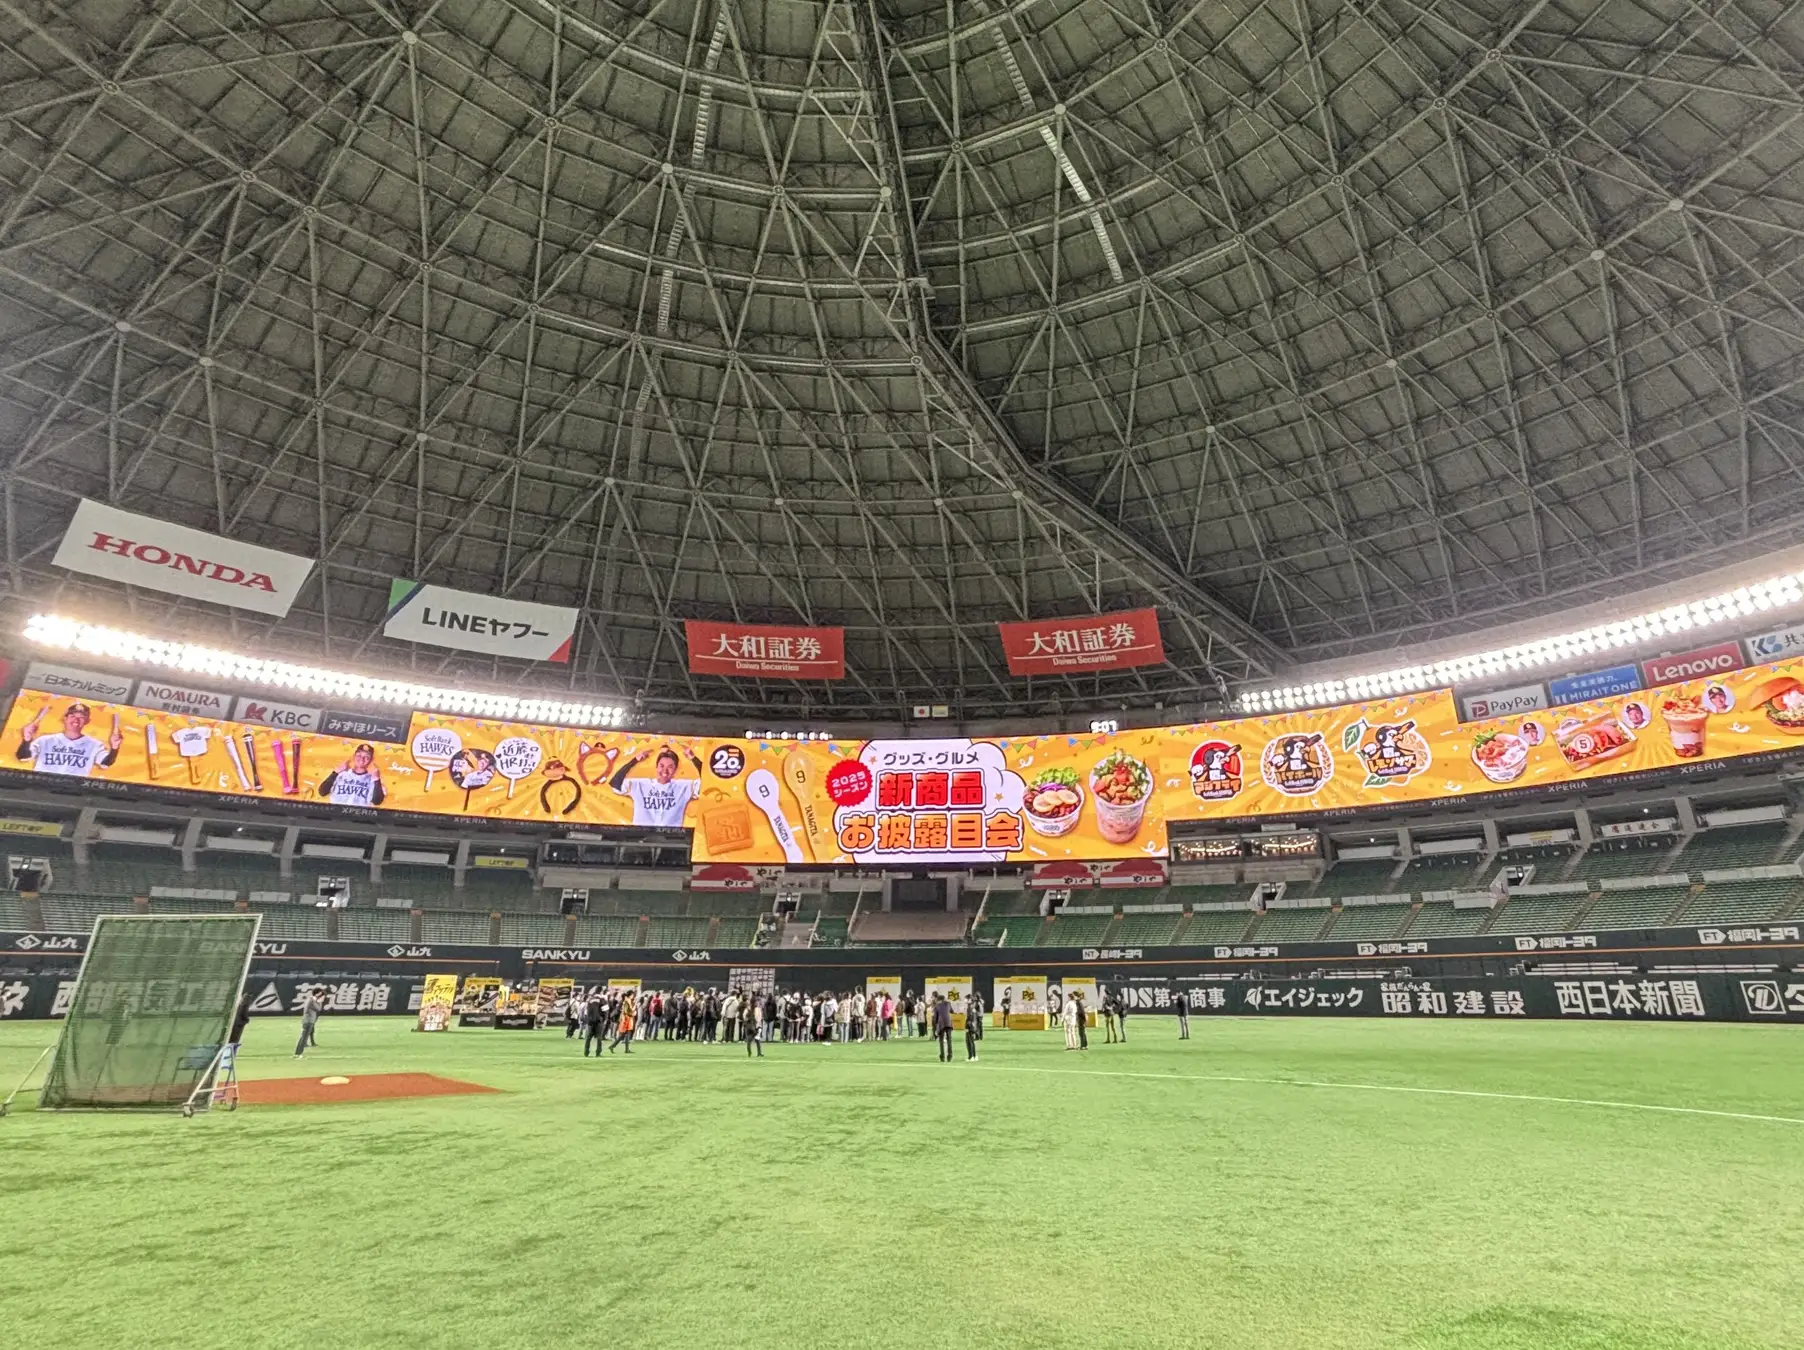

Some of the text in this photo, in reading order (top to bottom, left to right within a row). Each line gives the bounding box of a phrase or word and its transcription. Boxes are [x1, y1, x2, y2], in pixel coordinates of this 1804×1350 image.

[88, 532, 278, 593] HONDA
[423, 607, 549, 639] LINEヤフー
[713, 633, 821, 660] 大和証券
[1028, 624, 1136, 655] 大和証券
[736, 660, 799, 672] Daiwa Securities
[1053, 653, 1117, 666] Daiwa Securities
[1652, 654, 1733, 681] Lenovo
[44, 676, 128, 697] 日本カルミック
[1570, 688, 1608, 701] MIRAIT
[1611, 681, 1638, 693] ONE
[146, 685, 220, 708] NOMURA
[1491, 695, 1538, 713] PayPay
[270, 709, 311, 728] KBC
[328, 719, 397, 738] みずほリース
[420, 743, 454, 756] HAWKS
[1578, 740, 1588, 750] 5
[44, 753, 89, 769] HAWKS
[884, 752, 980, 766] グッズ・グルメ
[1679, 761, 1727, 775] XPERIA
[796, 770, 806, 783] 9
[831, 771, 866, 788] 2025
[82, 779, 129, 792] XPERIA
[758, 784, 770, 798] 9
[834, 781, 868, 798] シーズン
[878, 771, 984, 807] 新商品
[1547, 782, 1588, 793] XPERIA
[219, 795, 260, 806] XPERIA
[1430, 797, 1467, 806] XPERIA
[342, 807, 378, 817] XPERIA
[1323, 809, 1357, 818] XPERIA
[841, 814, 1022, 852] お披露目会
[43, 936, 78, 949] 山九
[1518, 935, 1597, 949] FT 福岡トヨタ
[1703, 927, 1800, 942] FT 福岡トヨタ
[407, 946, 431, 957] 山九
[521, 949, 591, 961] SANKYU
[688, 950, 711, 961] 山九
[290, 982, 391, 1012] 英進館
[1153, 987, 1226, 1009] 第一商事
[1265, 986, 1364, 1008] エイジェック
[1381, 991, 1526, 1015] 昭和建設
[1554, 980, 1706, 1016] 西日本新聞
